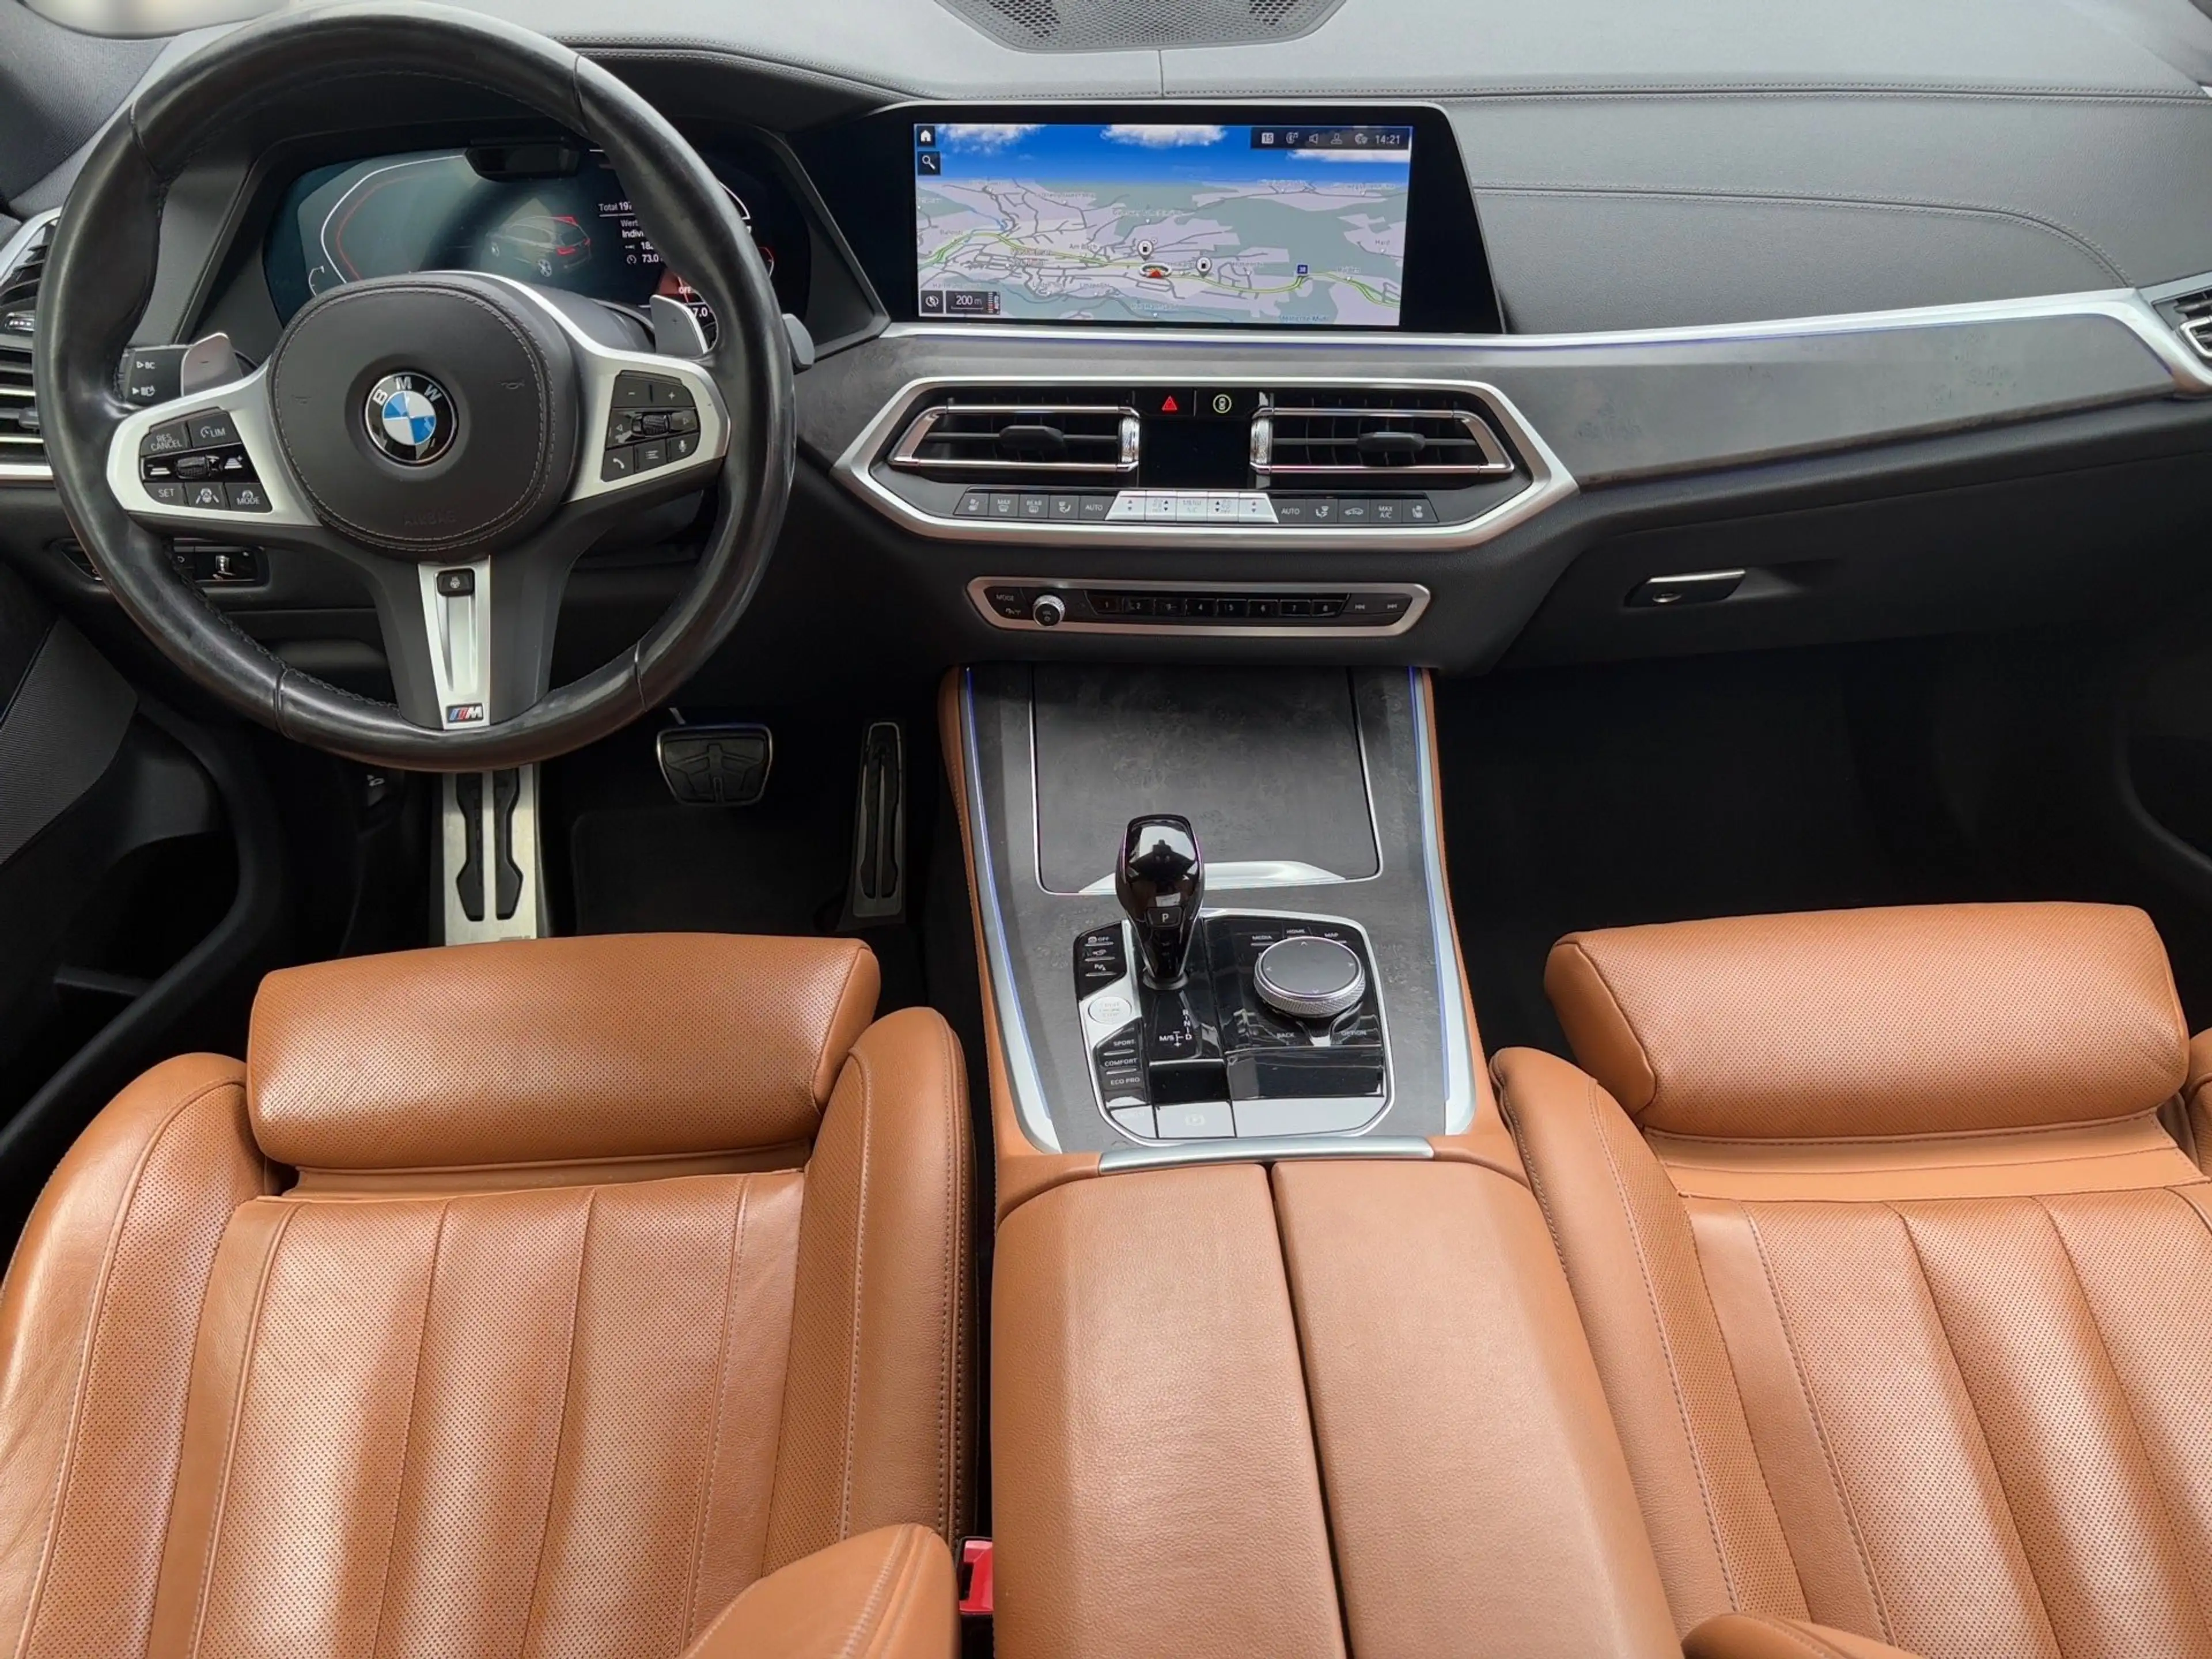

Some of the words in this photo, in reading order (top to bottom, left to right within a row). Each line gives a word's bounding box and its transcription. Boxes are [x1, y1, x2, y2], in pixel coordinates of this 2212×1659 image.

[1376, 134, 1400, 145] 14:21
[599, 203, 618, 211] Total
[642, 254, 659, 263] 73.0
[956, 295, 973, 305] 200
[372, 376, 442, 406] BMW
[211, 428, 225, 437] LIM
[156, 433, 172, 442] RES
[150, 441, 183, 452] CANCEL
[158, 488, 175, 498] SET
[236, 496, 260, 505] MODE
[1162, 914, 1169, 922] P
[1104, 1058, 1137, 1066] COMFORT
[1110, 1078, 1124, 1086] ECO
